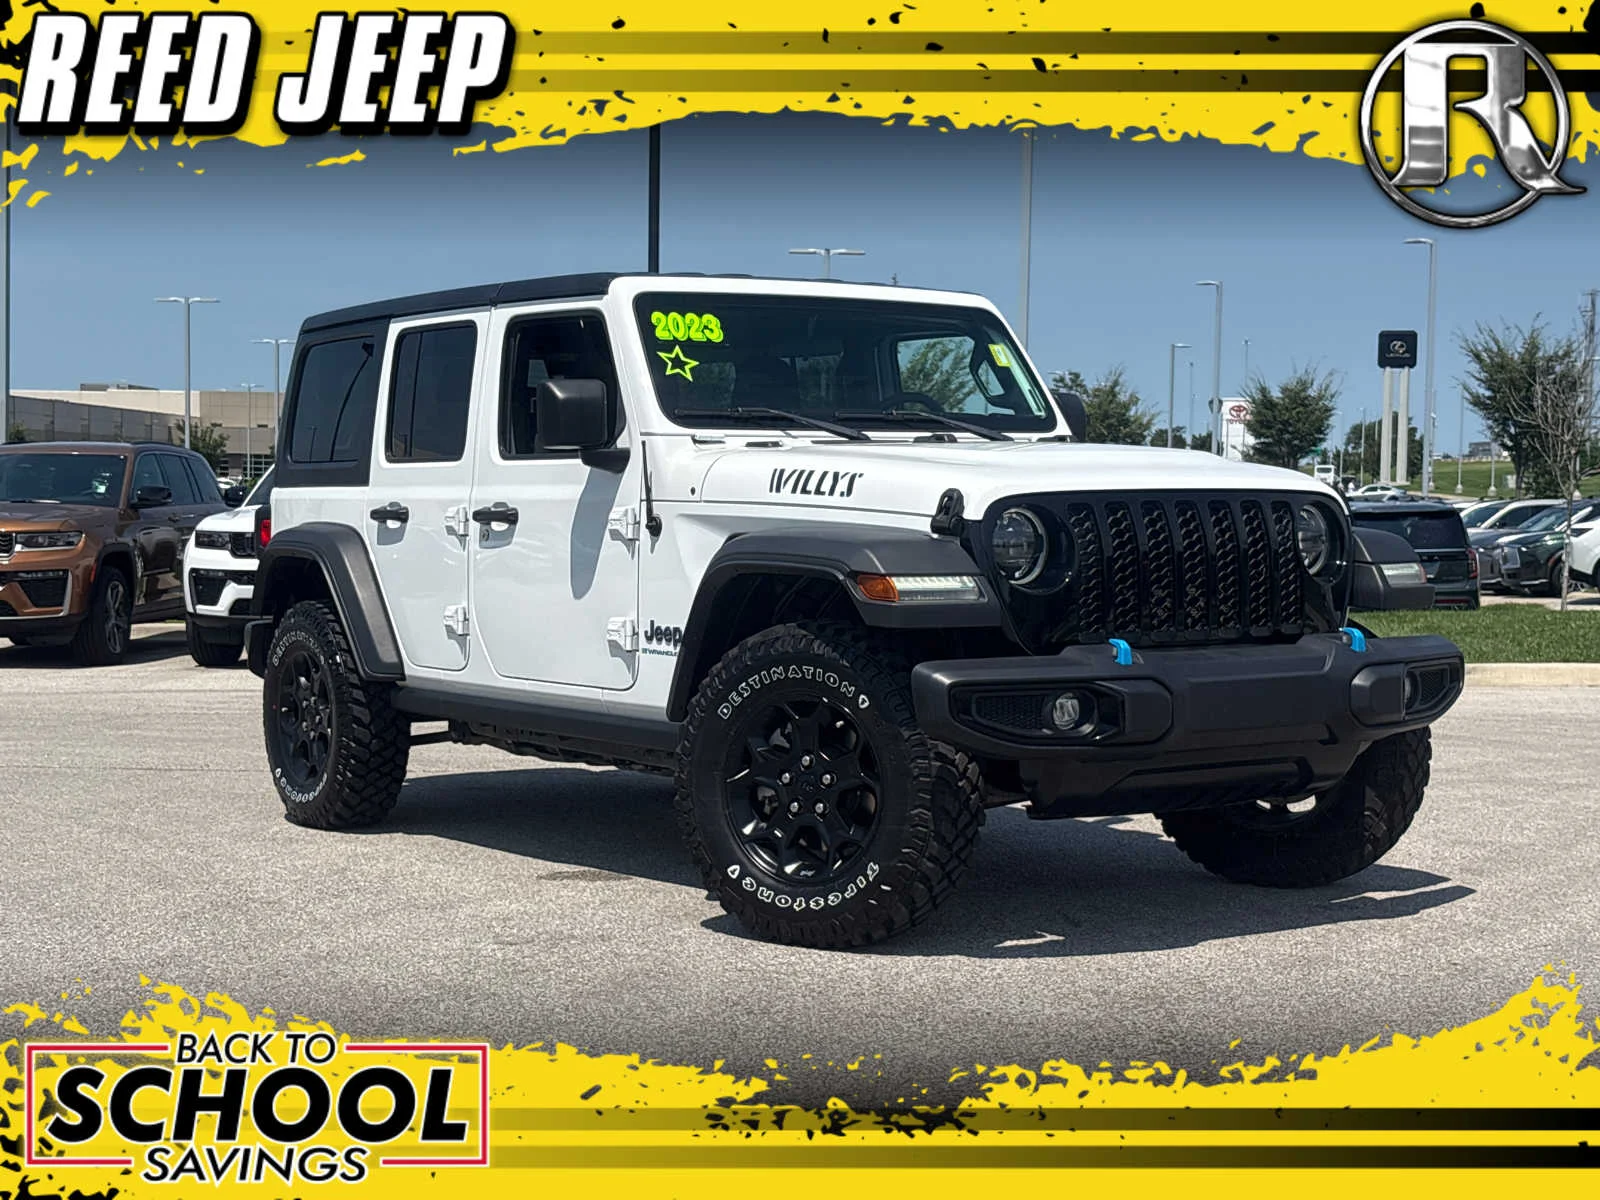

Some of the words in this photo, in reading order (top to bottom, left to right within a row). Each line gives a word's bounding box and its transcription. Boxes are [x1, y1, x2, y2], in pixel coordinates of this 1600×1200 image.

[651, 311, 724, 343] 2023
[768, 468, 864, 498] WILLYS
[644, 619, 683, 650] Jeep
[717, 665, 856, 720] DESTINATION
[742, 861, 880, 911] Firestone
